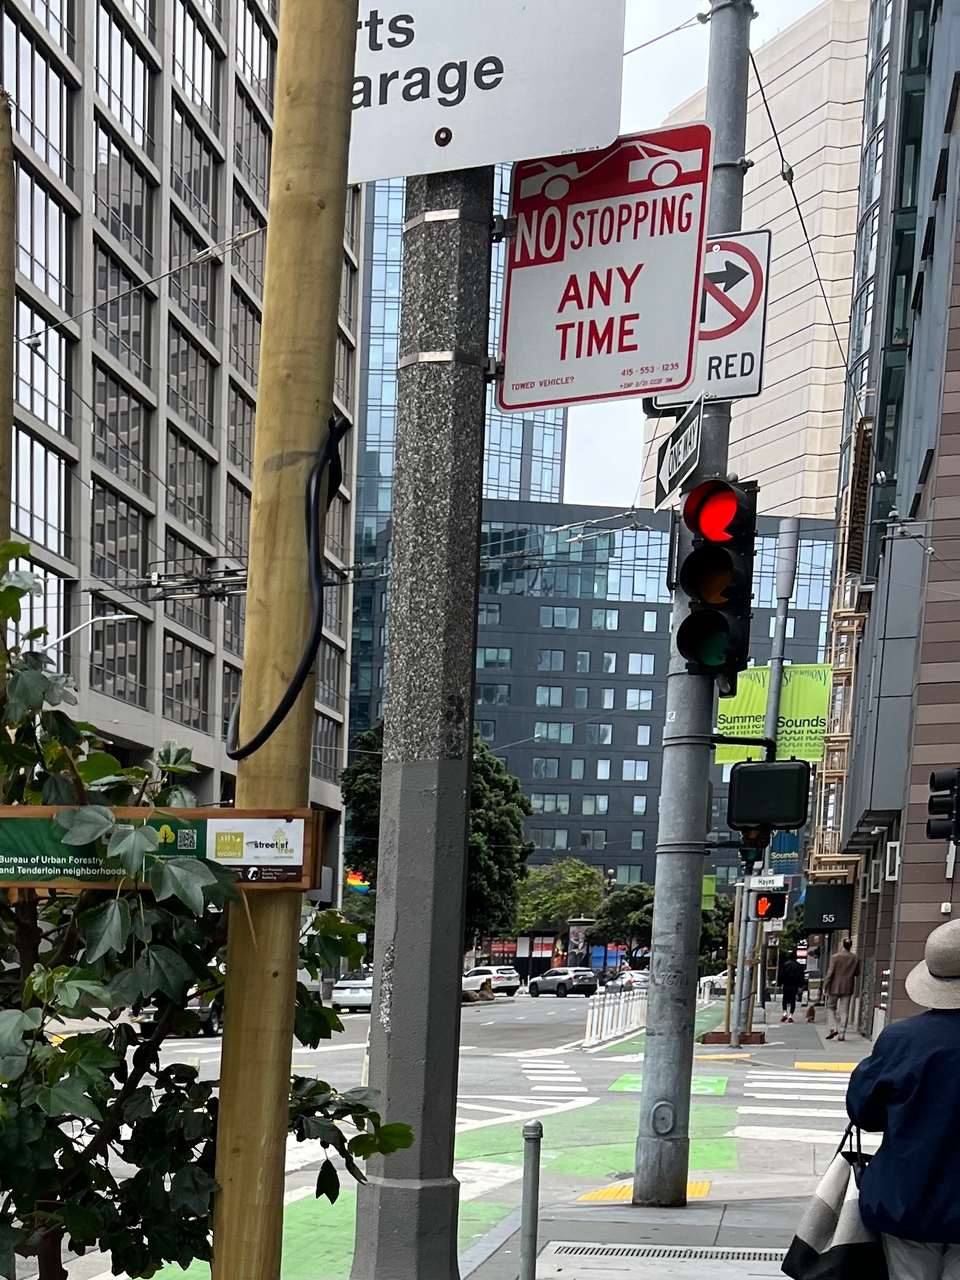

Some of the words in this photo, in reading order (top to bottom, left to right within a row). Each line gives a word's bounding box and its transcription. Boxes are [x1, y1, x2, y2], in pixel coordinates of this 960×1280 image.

[356, 9, 415, 51] ts
[515, 206, 562, 263] NO
[570, 193, 694, 250] STOPPING
[557, 263, 644, 313] ANY
[555, 313, 640, 361] TIME
[707, 352, 755, 381] RED
[511, 381, 535, 391] TOWED
[539, 376, 575, 387] VEHICLE?
[776, 715, 826, 728] Sounds
[254, 841, 279, 849] street
[280, 841, 289, 849] sf
[30, 855, 39, 864] of
[41, 855, 67, 864] Urban
[69, 856, 106, 866] Forestry.
[771, 851, 799, 860] Sounds
[0, 866, 15, 875] and
[17, 866, 61, 875] Tenderloin
[758, 879, 775, 887] Hayes
[822, 914, 835, 923] 55
